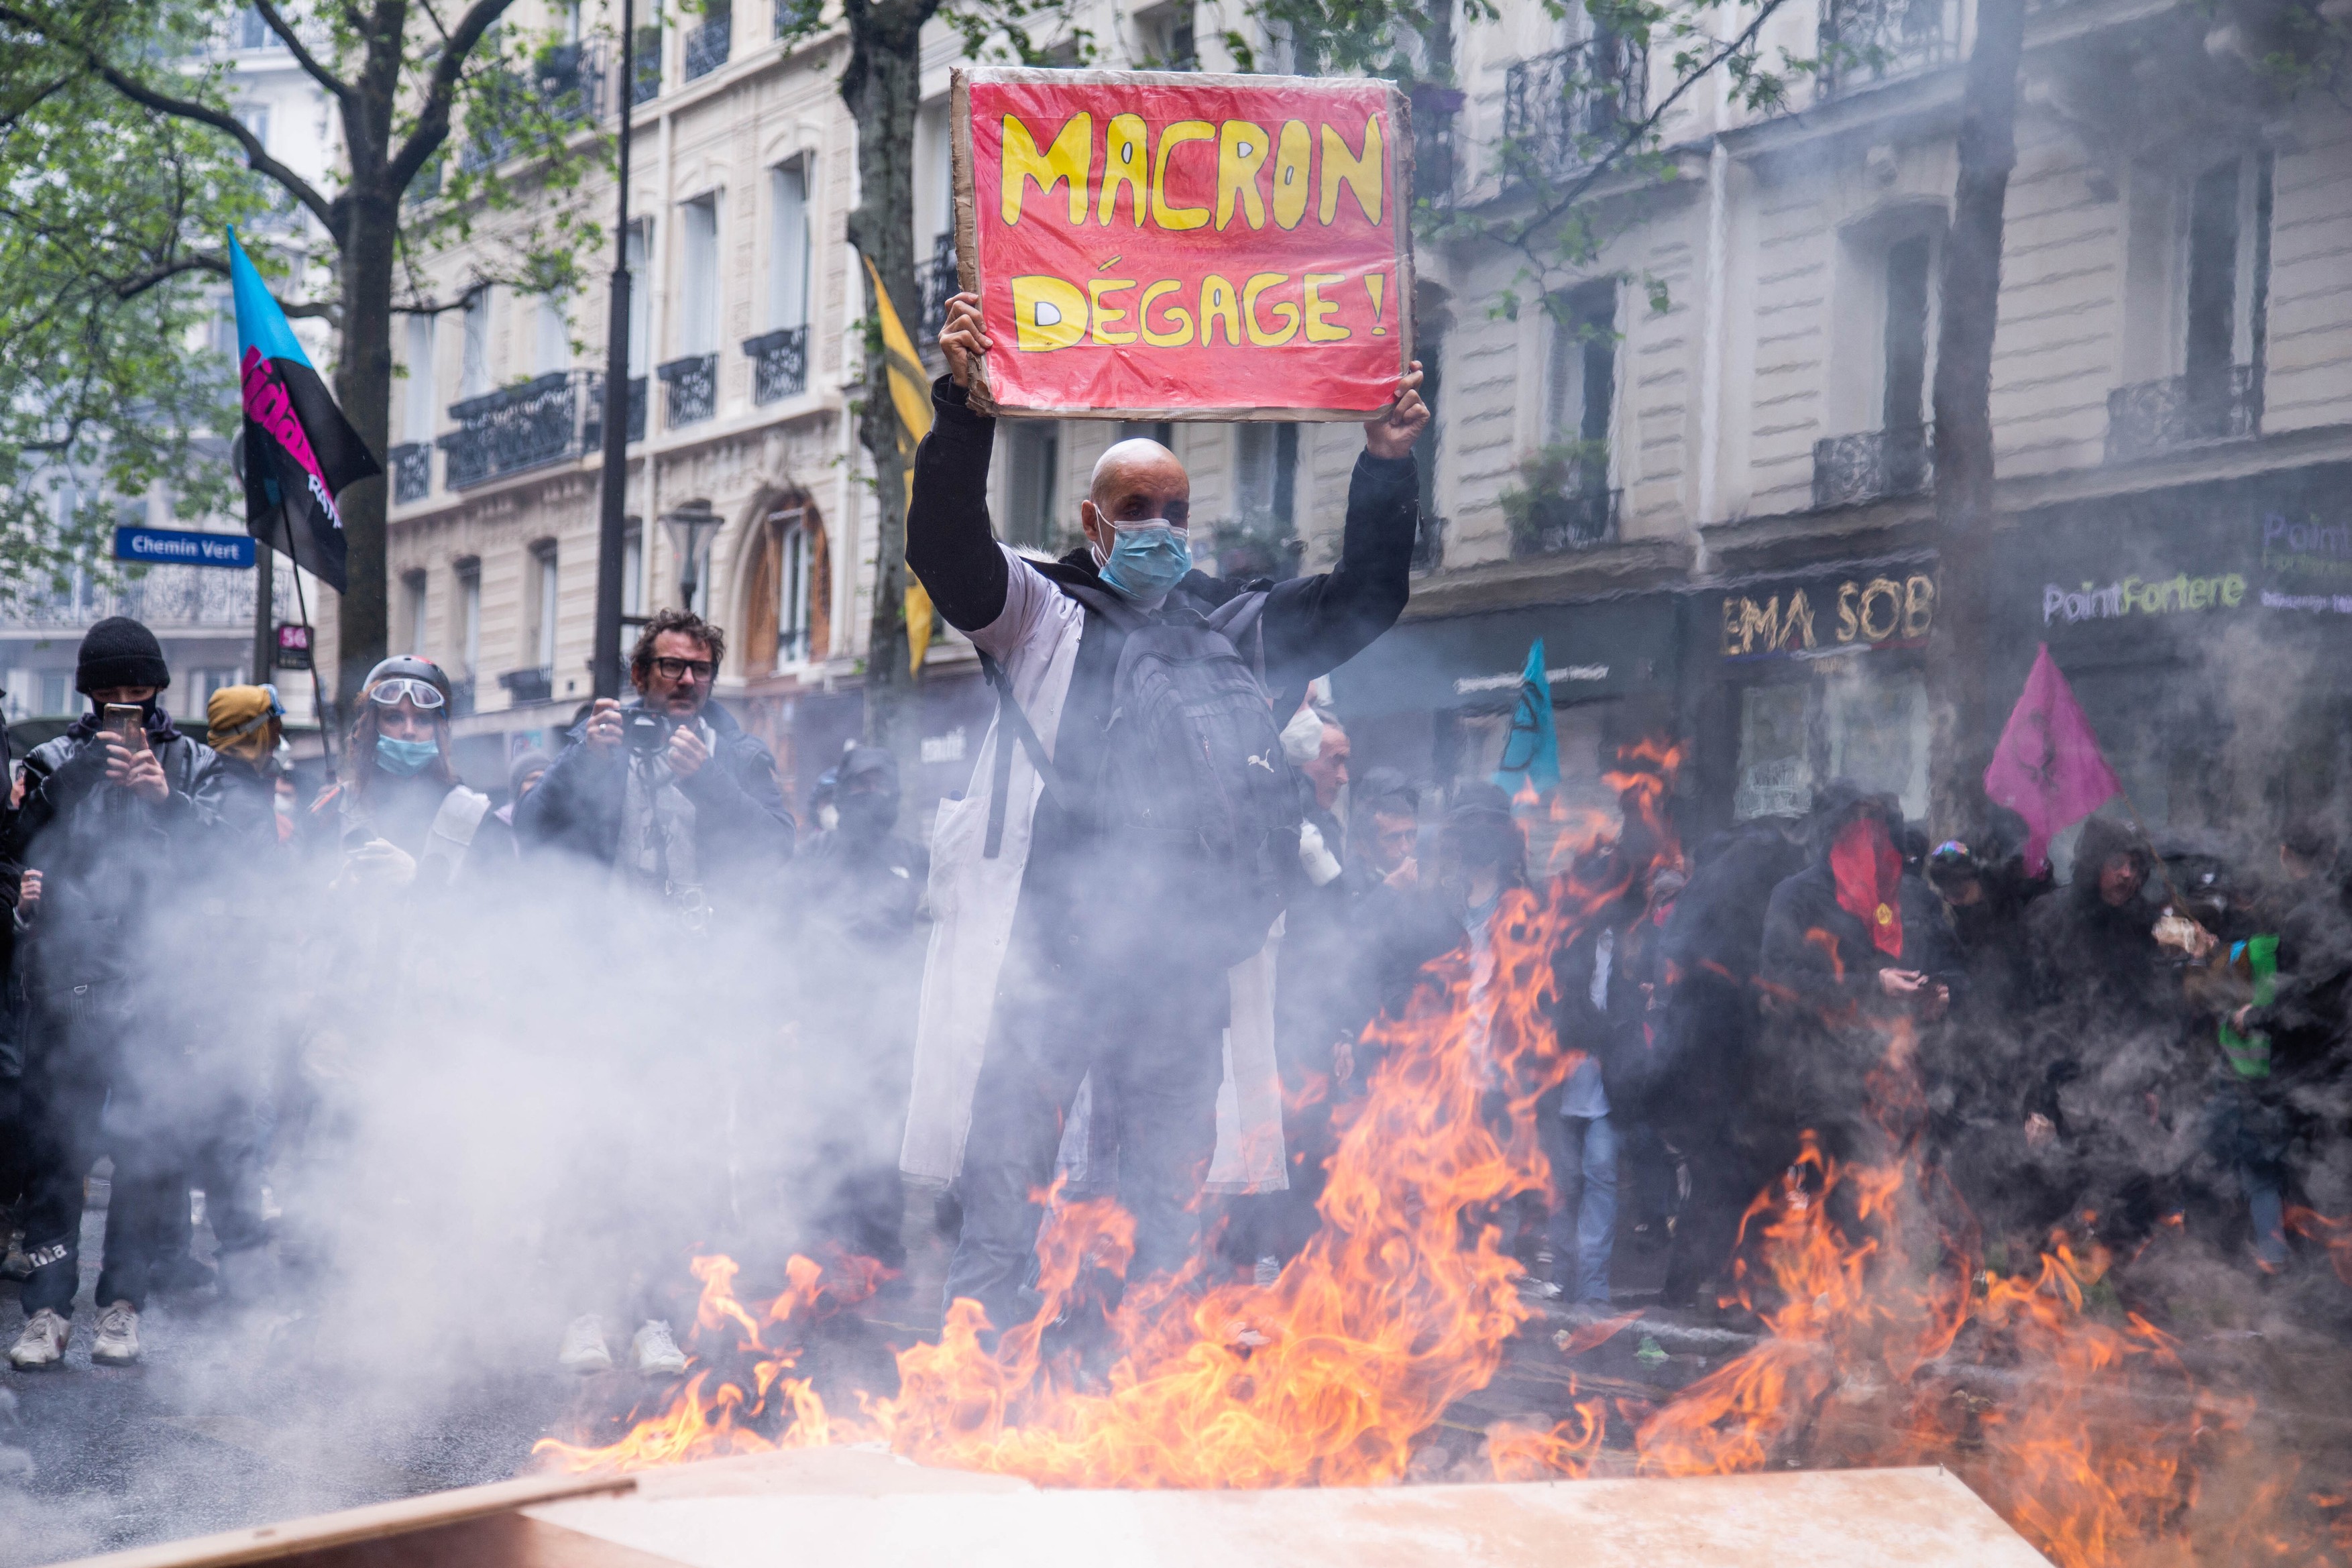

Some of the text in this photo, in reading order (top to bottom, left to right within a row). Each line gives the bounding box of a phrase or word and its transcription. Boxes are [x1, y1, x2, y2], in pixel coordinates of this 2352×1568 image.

[1001, 111, 1383, 231] MACRON
[131, 535, 240, 561] Chemin Vert
